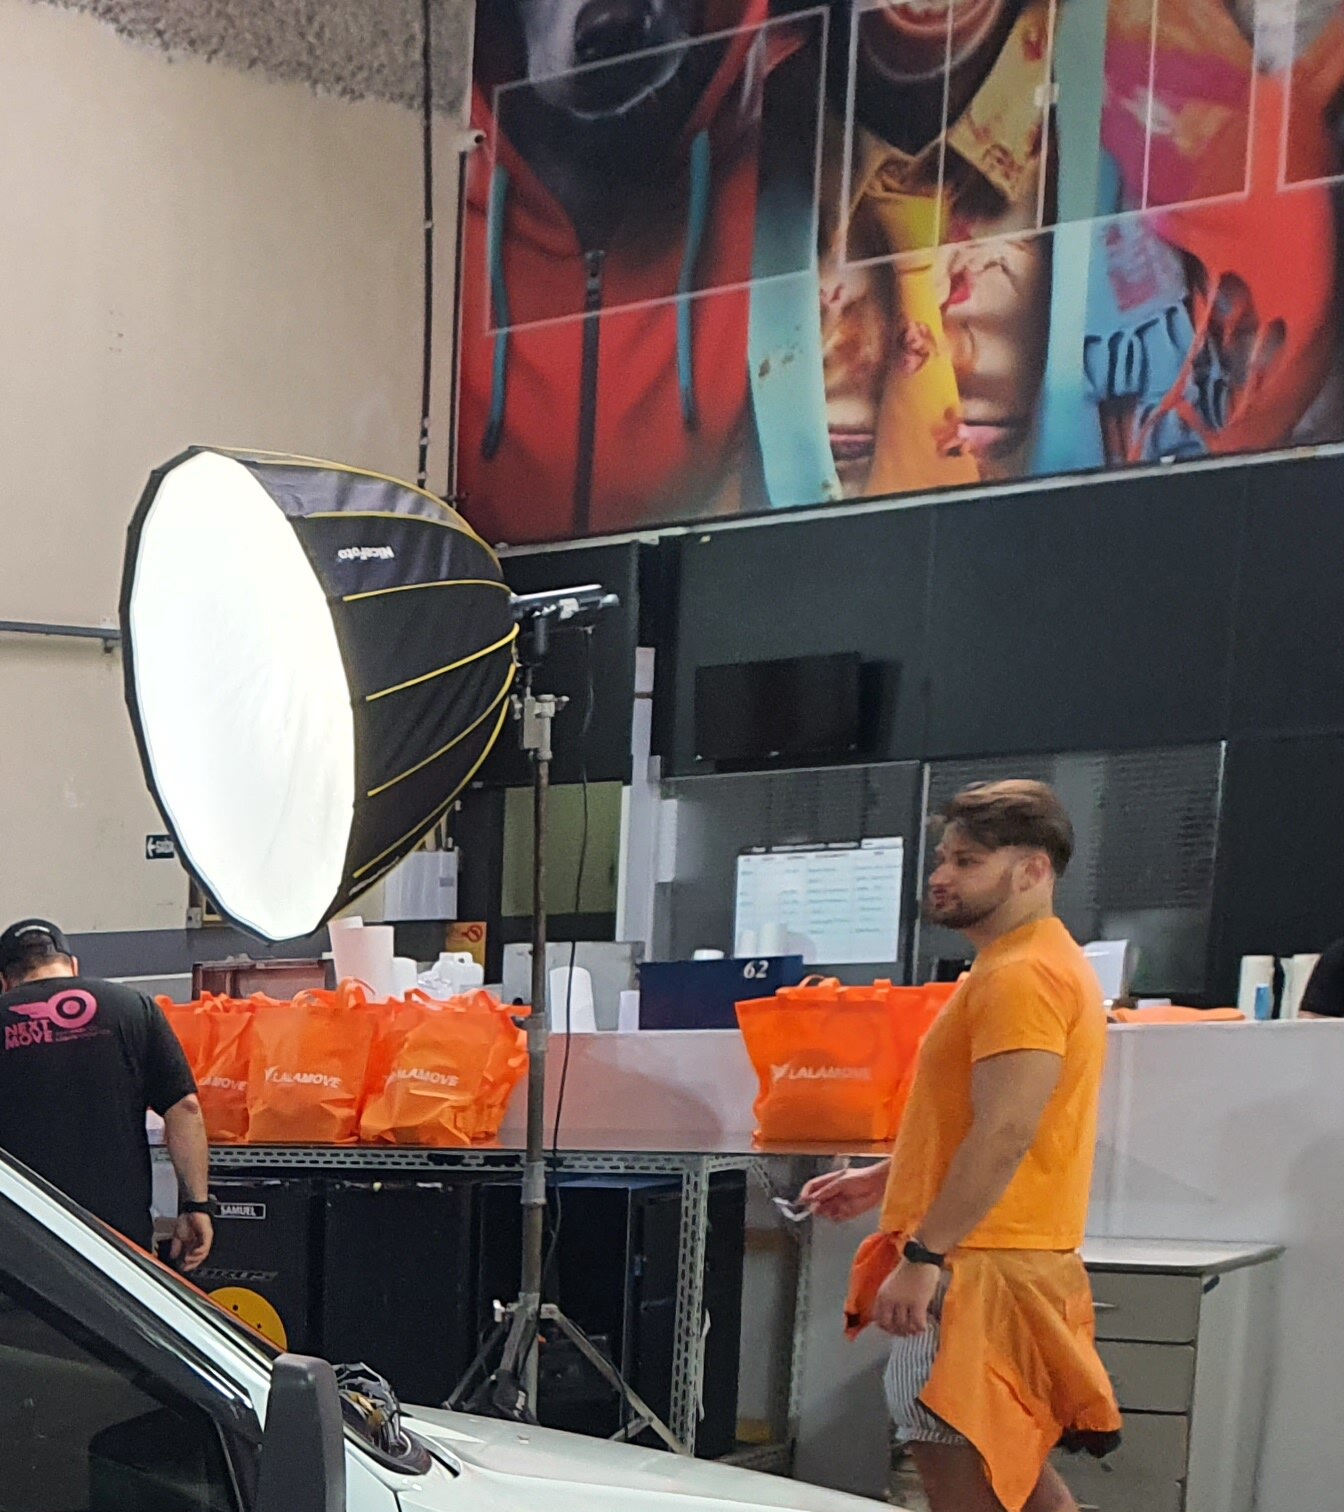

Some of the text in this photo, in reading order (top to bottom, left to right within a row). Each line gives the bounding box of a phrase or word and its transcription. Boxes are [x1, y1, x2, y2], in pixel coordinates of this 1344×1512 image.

[743, 960, 769, 979] 62
[5, 1019, 50, 1037] NEXT
[5, 1031, 53, 1050] MOVE
[220, 1205, 257, 1216] SAMUEL
